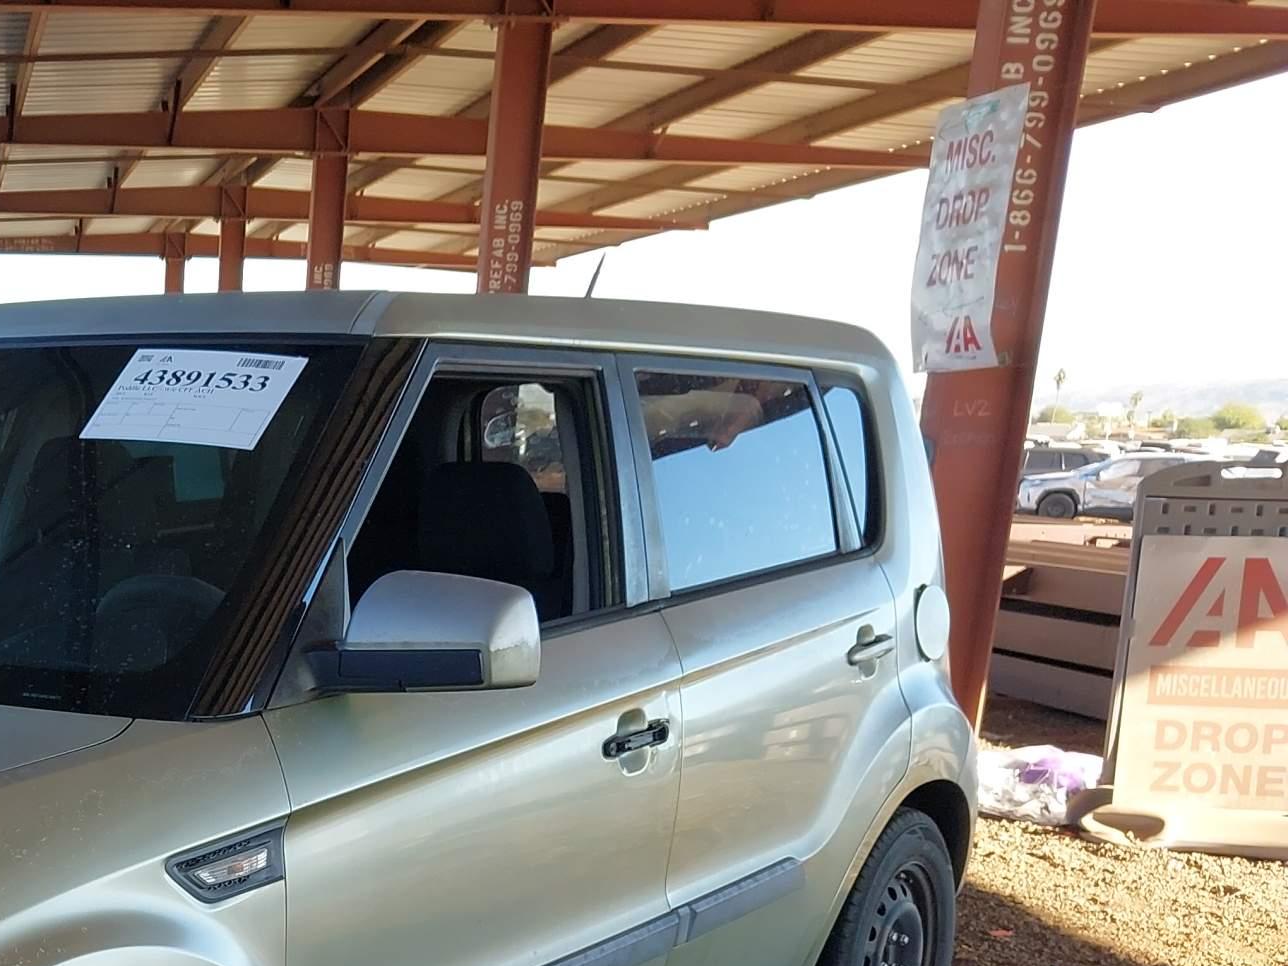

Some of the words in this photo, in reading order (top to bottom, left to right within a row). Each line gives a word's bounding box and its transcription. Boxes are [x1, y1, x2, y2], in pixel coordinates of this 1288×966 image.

[945, 130, 996, 174] MISC.
[934, 187, 991, 231] DROP
[488, 238, 505, 294] REFAB
[926, 244, 979, 288] ZONE
[134, 368, 270, 391] 43891533
[1154, 719, 1288, 754] DROP
[1149, 761, 1287, 797] ZONE
